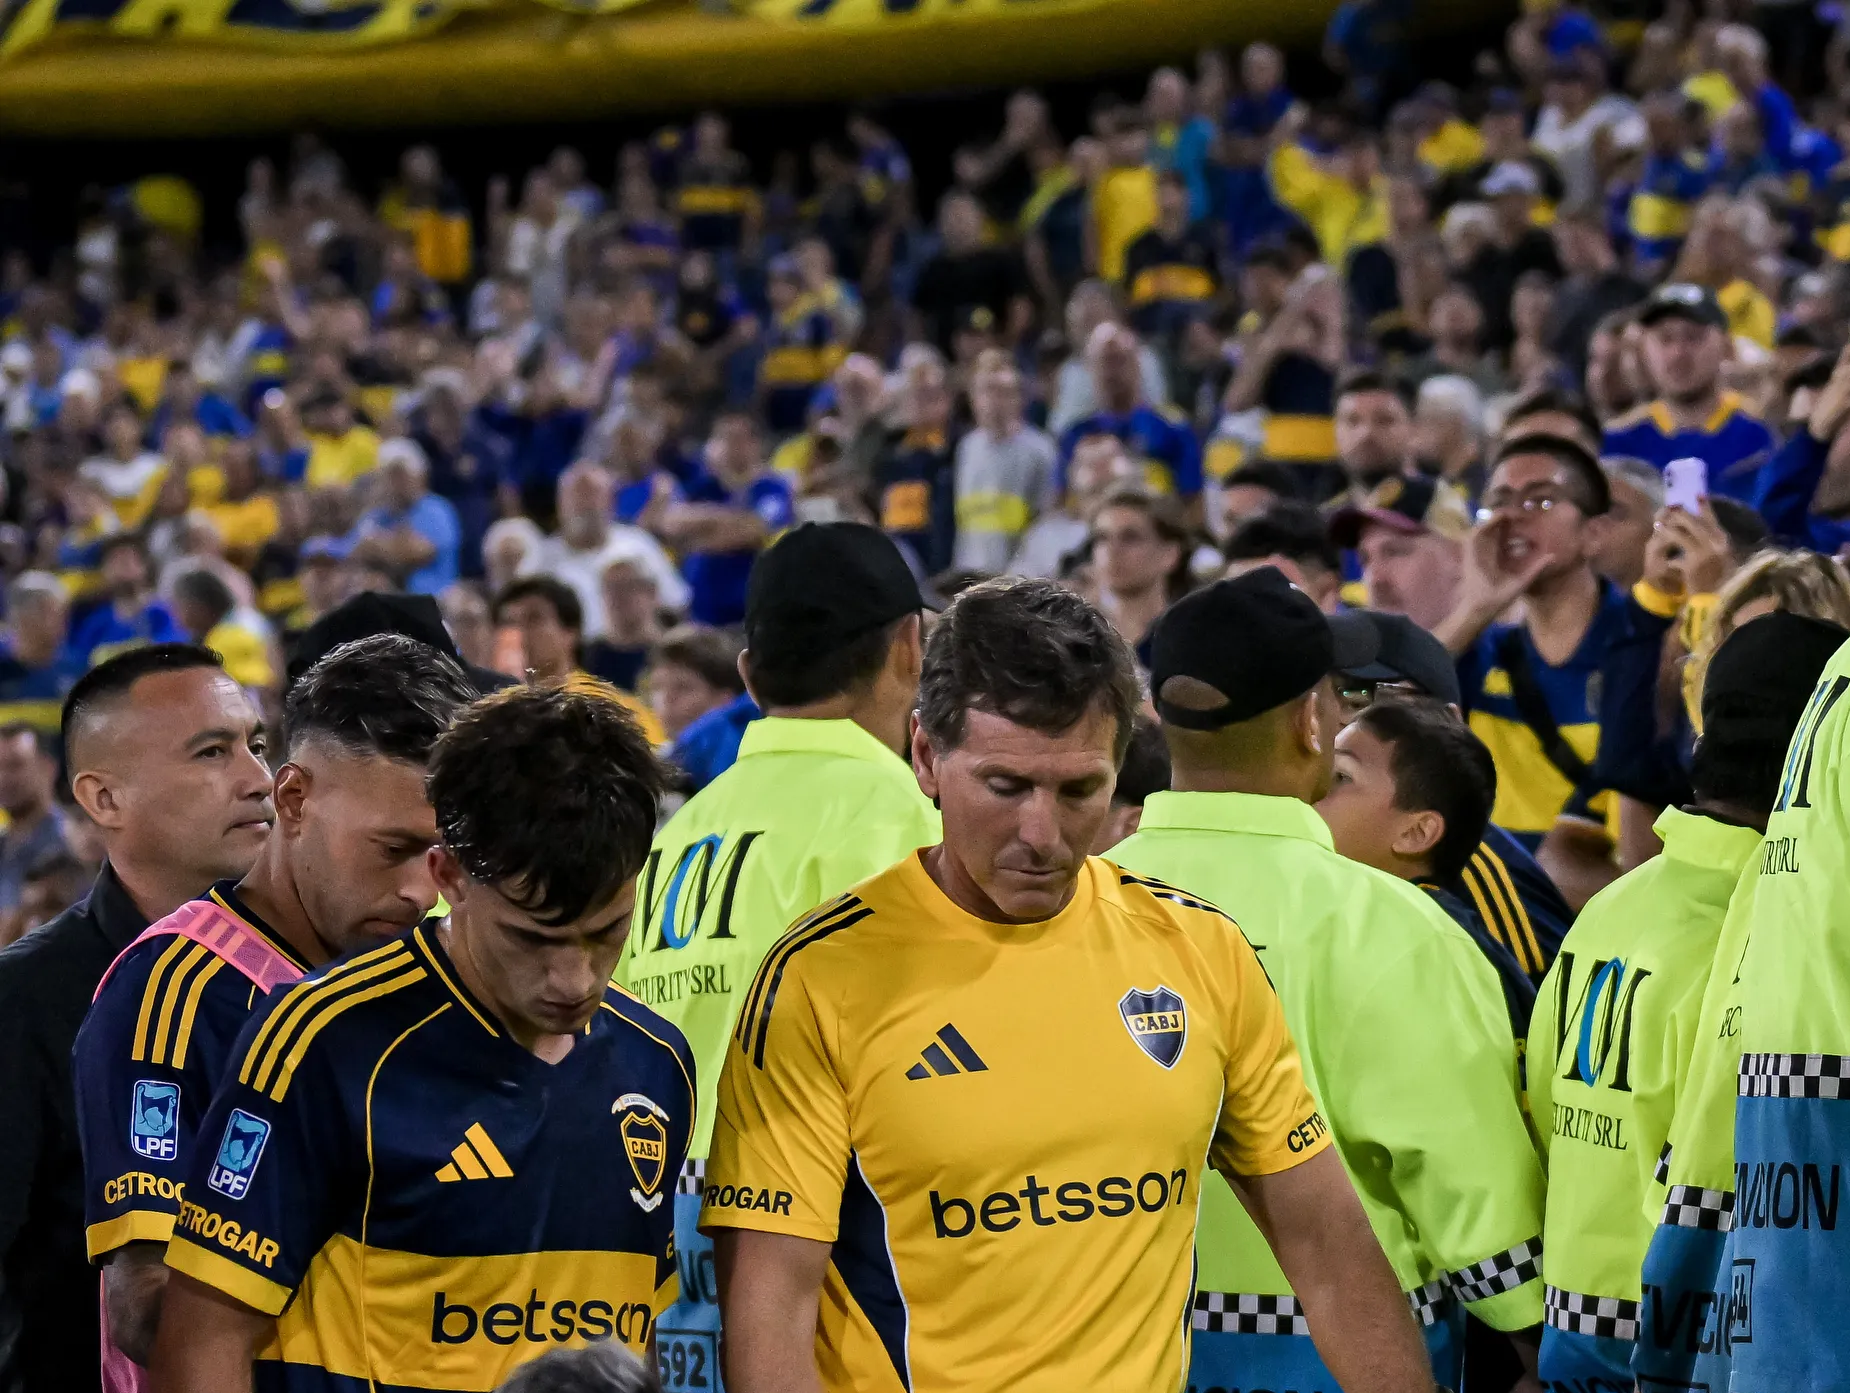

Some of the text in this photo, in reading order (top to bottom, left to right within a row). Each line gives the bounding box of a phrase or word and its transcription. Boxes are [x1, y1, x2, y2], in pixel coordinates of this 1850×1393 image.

[690, 963, 731, 994] SRL
[1134, 1013, 1179, 1032] CABJ
[134, 1135, 174, 1157] LPF
[1593, 1112, 1628, 1151] SRL
[631, 1140, 660, 1158] CABJ
[210, 1164, 248, 1195] LPF
[928, 1166, 1188, 1239] betsson
[431, 1287, 652, 1345] betsson
